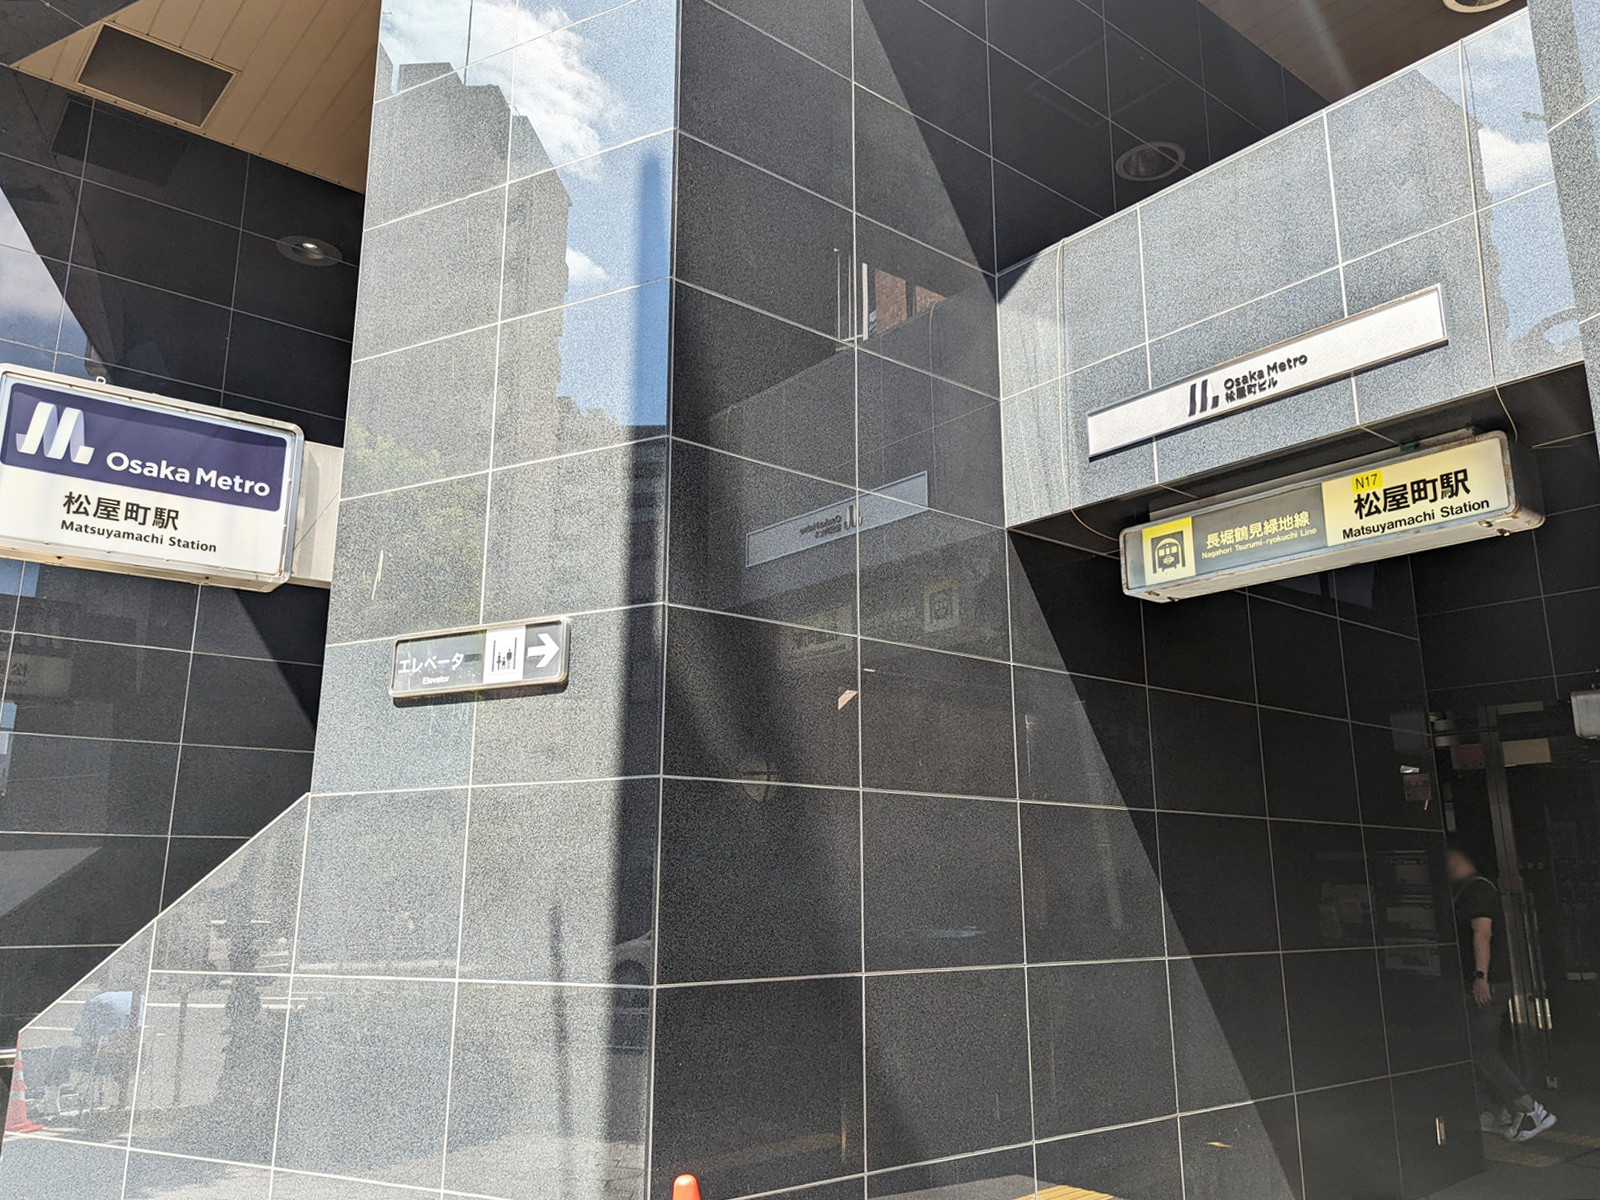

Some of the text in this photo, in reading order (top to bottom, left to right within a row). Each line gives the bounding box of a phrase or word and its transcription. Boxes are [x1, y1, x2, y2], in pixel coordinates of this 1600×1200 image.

[1224, 354, 1308, 390] Osaka Metro
[1225, 377, 1278, 404] 松屋町ビル
[106, 451, 271, 497] Osaka Metro
[1354, 473, 1378, 490] N17
[62, 490, 180, 531] 松屋町駅
[1354, 468, 1471, 520] 松屋町駅
[60, 519, 217, 553] Matsuyamachi Station
[1206, 510, 1310, 549] 長堀鶴見緑地線
[1342, 499, 1490, 540] Matsuyamachi Station
[1201, 546, 1233, 559] Nagahori
[1300, 527, 1318, 537] Line
[398, 652, 464, 674] エレベータ
[422, 675, 450, 685] Elevator
